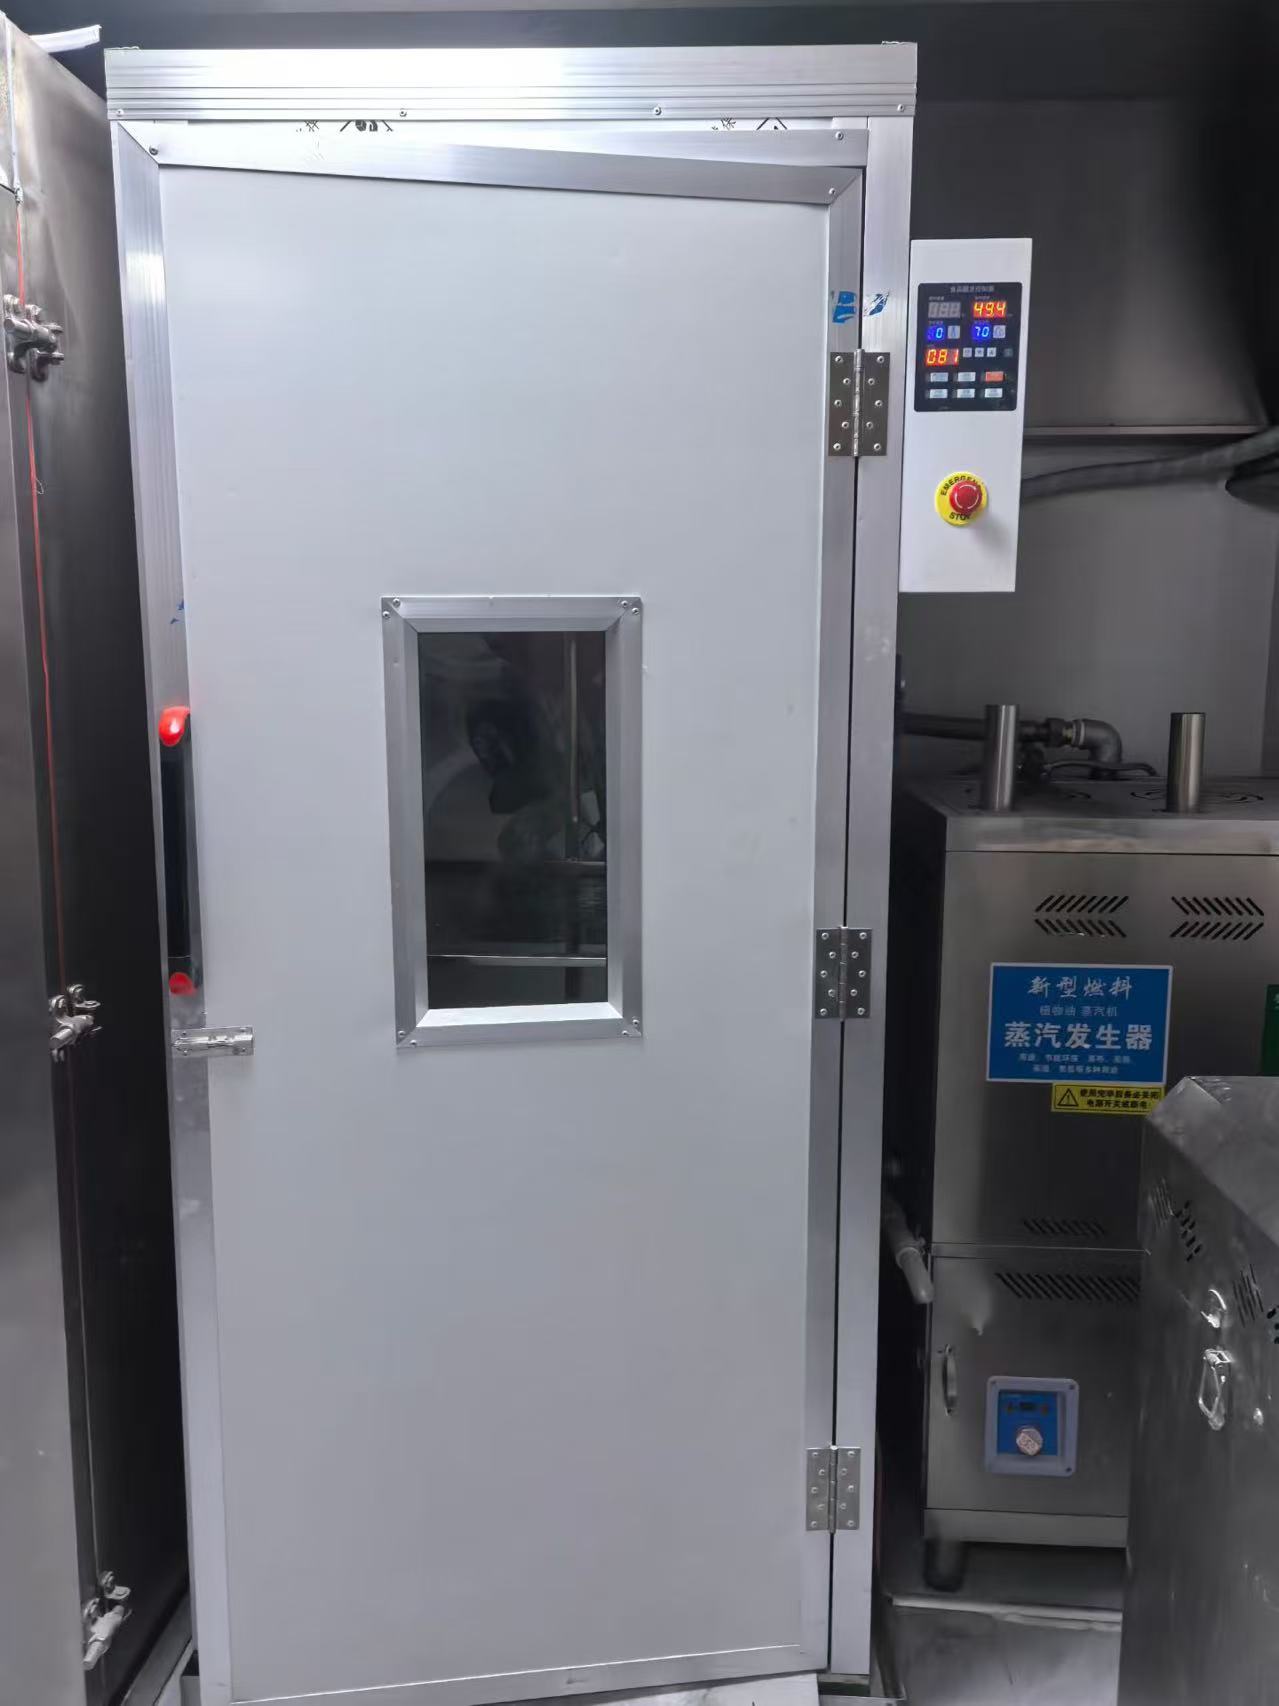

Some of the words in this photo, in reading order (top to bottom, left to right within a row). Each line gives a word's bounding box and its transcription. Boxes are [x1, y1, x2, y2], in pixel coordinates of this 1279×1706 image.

[974, 326, 990, 338] 70
[1027, 975, 1133, 1000] 新型燃料
[1080, 1006, 1118, 1017] 蒸汽机
[1004, 1021, 1153, 1050] 蒸汽发生器
